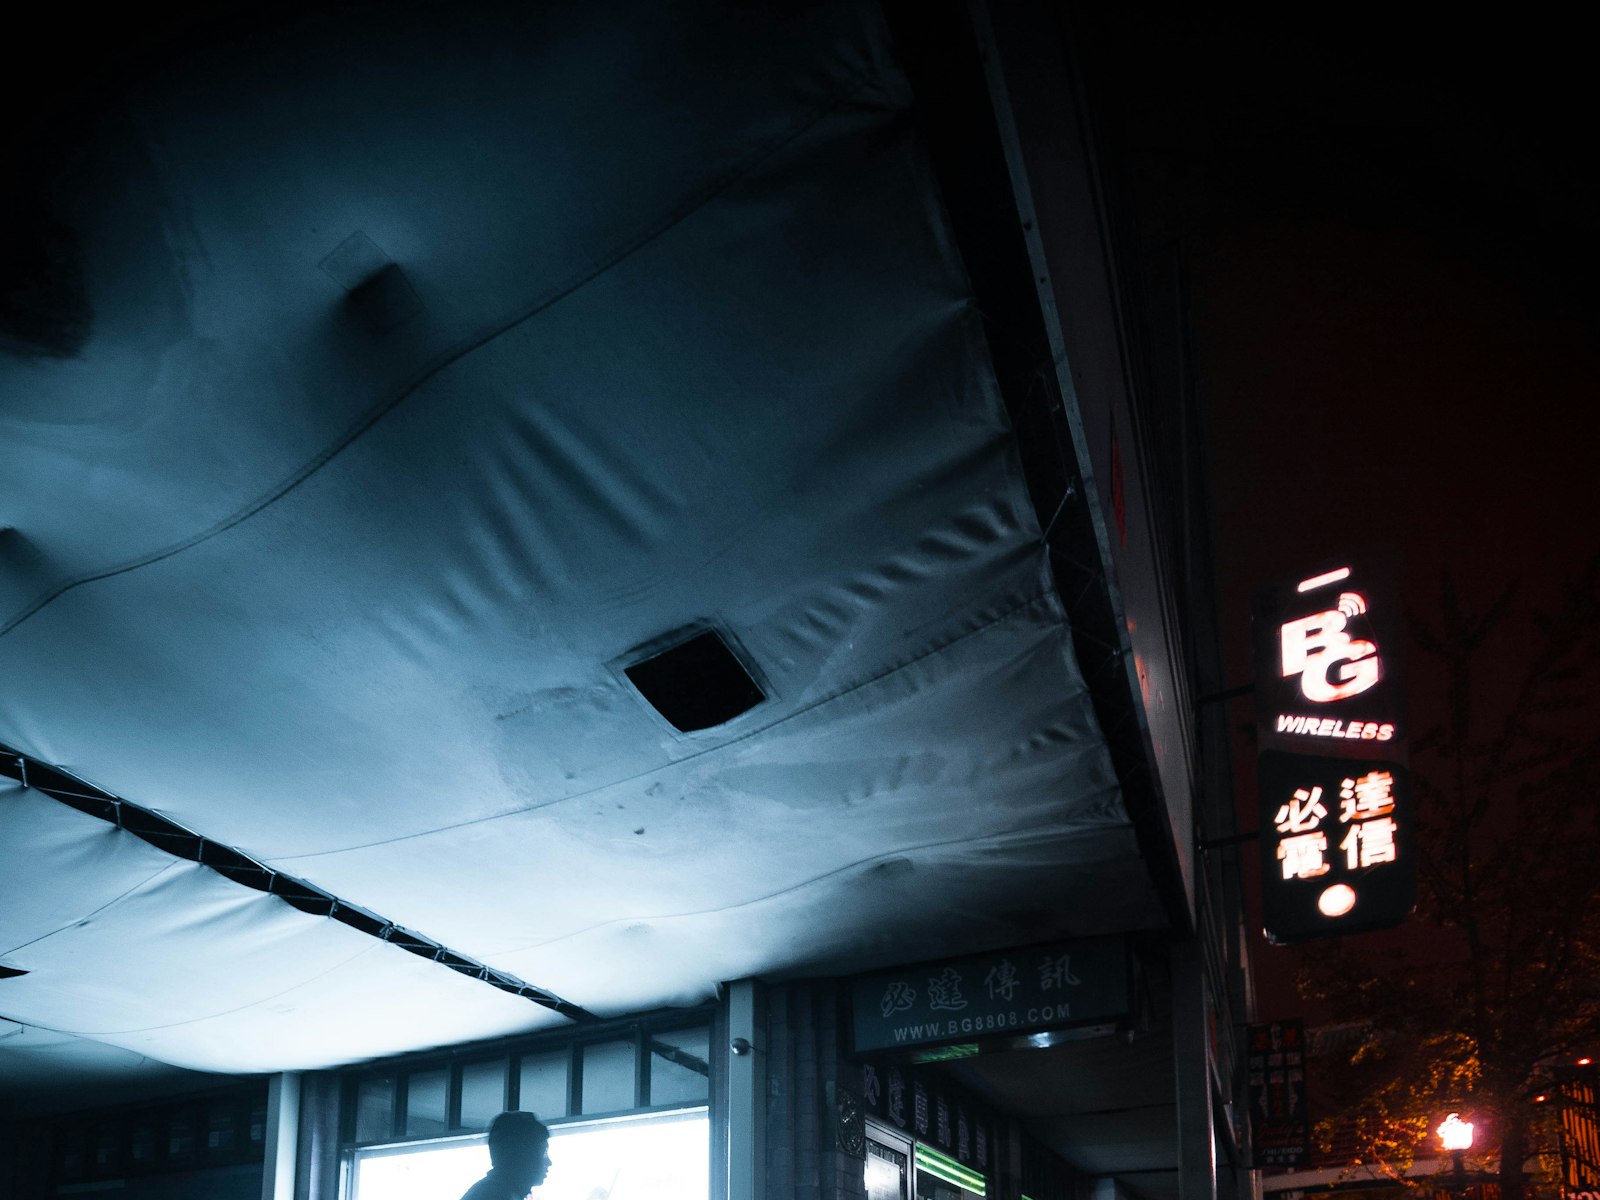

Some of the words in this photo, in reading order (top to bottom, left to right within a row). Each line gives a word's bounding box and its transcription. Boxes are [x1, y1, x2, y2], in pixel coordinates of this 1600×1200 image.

[1279, 607, 1382, 704] BG
[1275, 714, 1395, 741] WIRELESS
[893, 1002, 1072, 1042] WWW.BG8808.COM
